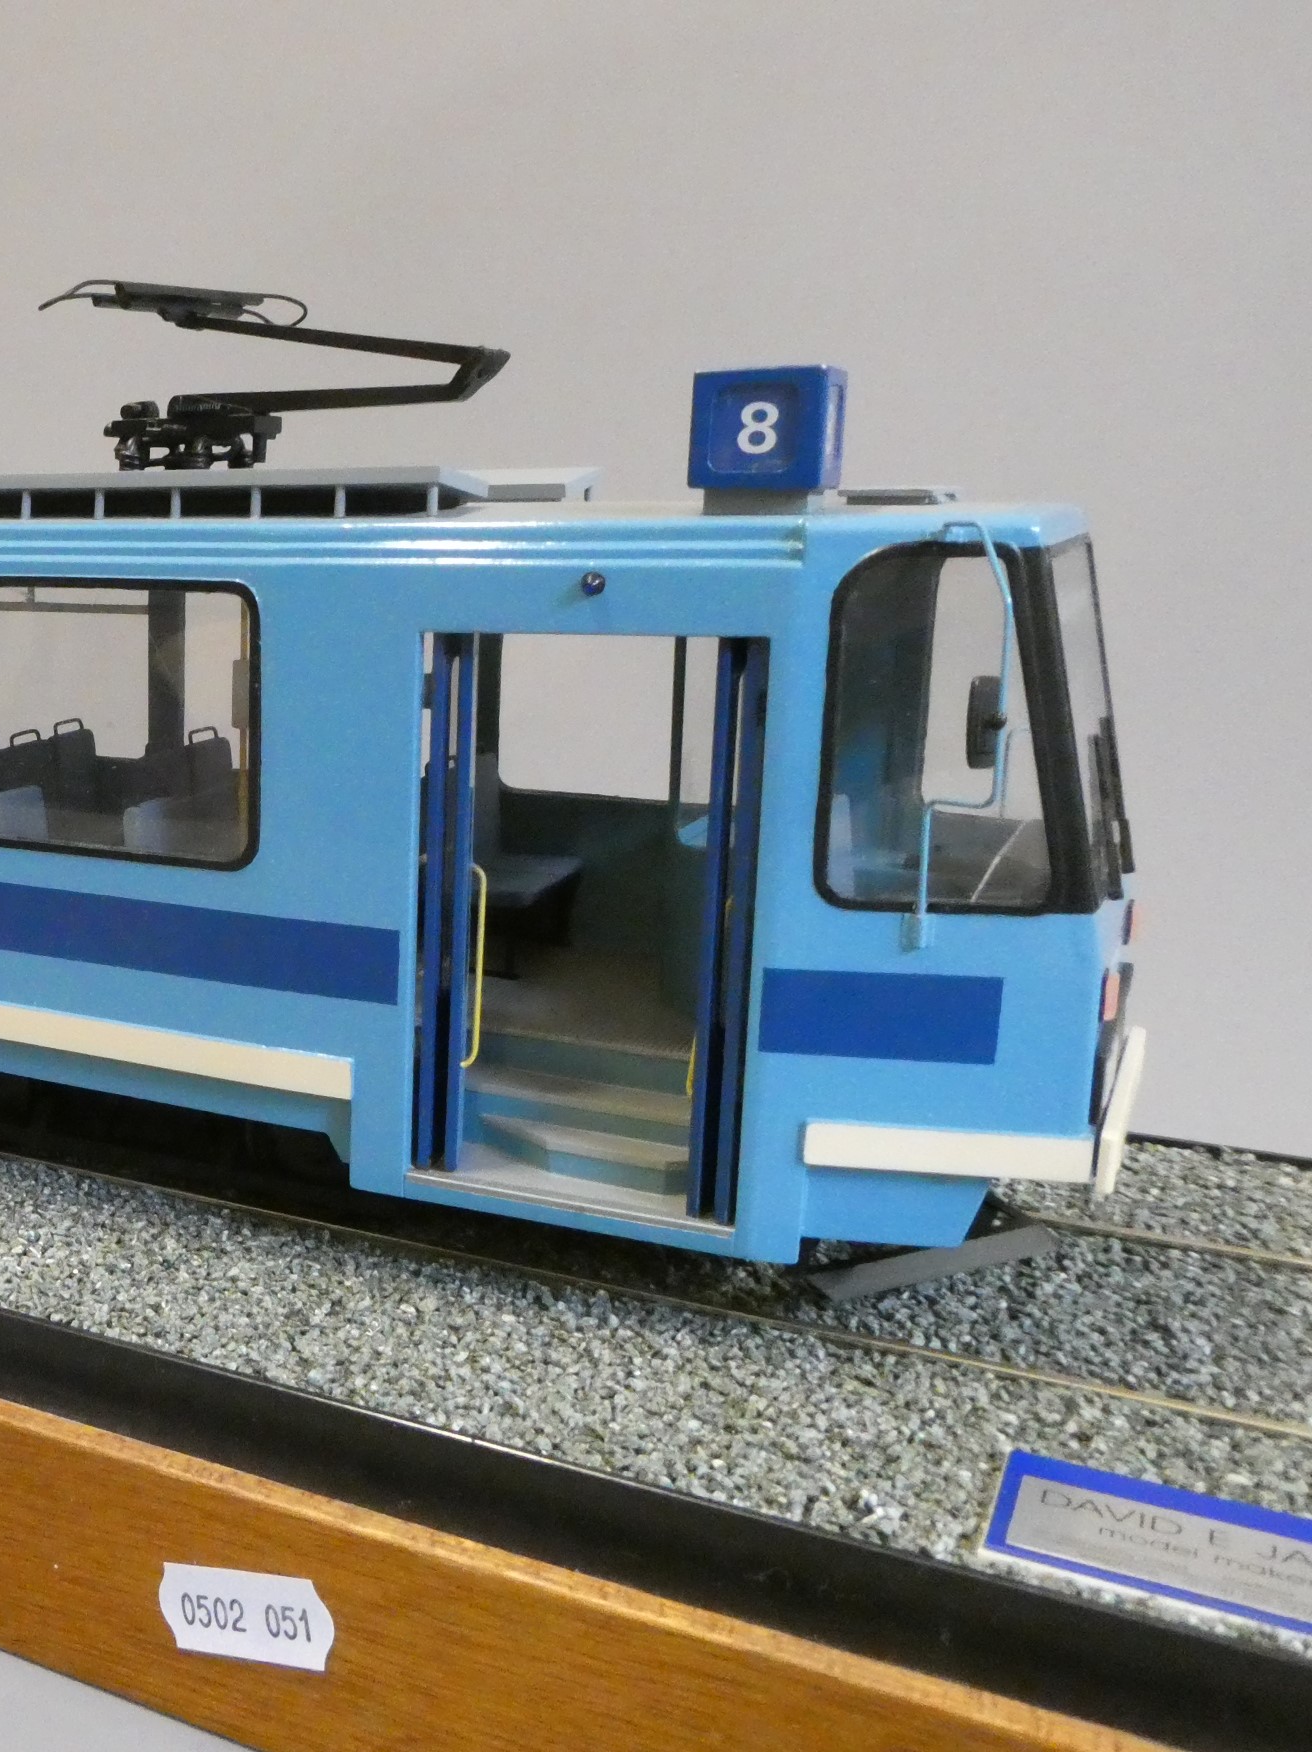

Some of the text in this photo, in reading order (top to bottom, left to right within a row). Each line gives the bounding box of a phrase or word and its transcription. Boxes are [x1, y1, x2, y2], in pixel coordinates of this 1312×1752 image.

[737, 401, 779, 454] 8
[1041, 1489, 1183, 1536] DAVID
[1209, 1528, 1228, 1549] E
[1099, 1527, 1199, 1559] model
[181, 1592, 312, 1643] 0502 051
